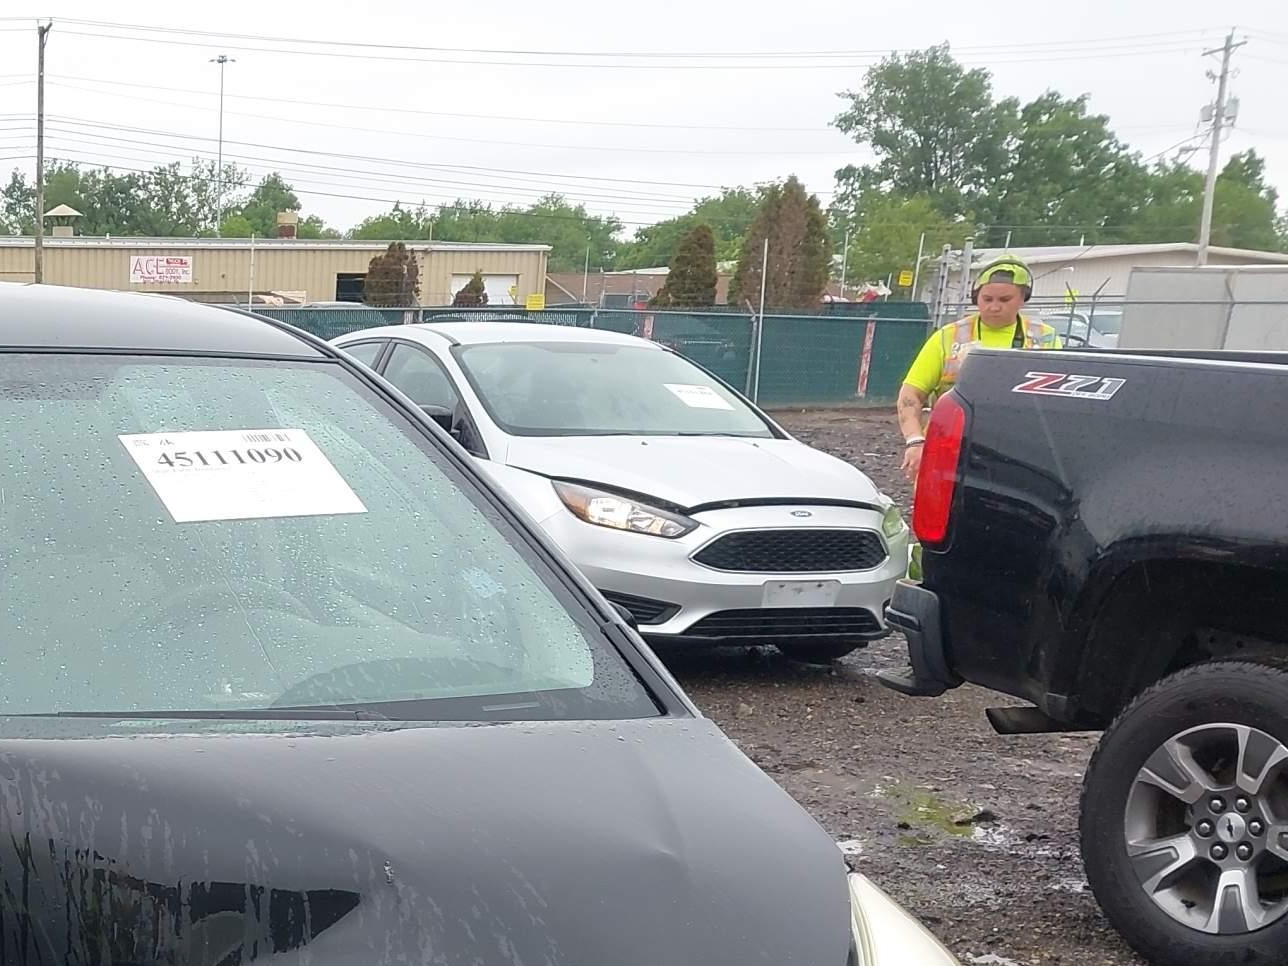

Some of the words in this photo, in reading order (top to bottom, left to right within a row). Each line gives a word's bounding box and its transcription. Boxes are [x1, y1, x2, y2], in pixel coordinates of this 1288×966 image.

[133, 257, 164, 275] ACE
[1011, 371, 1128, 401] Z71
[156, 447, 304, 468] 45111090
